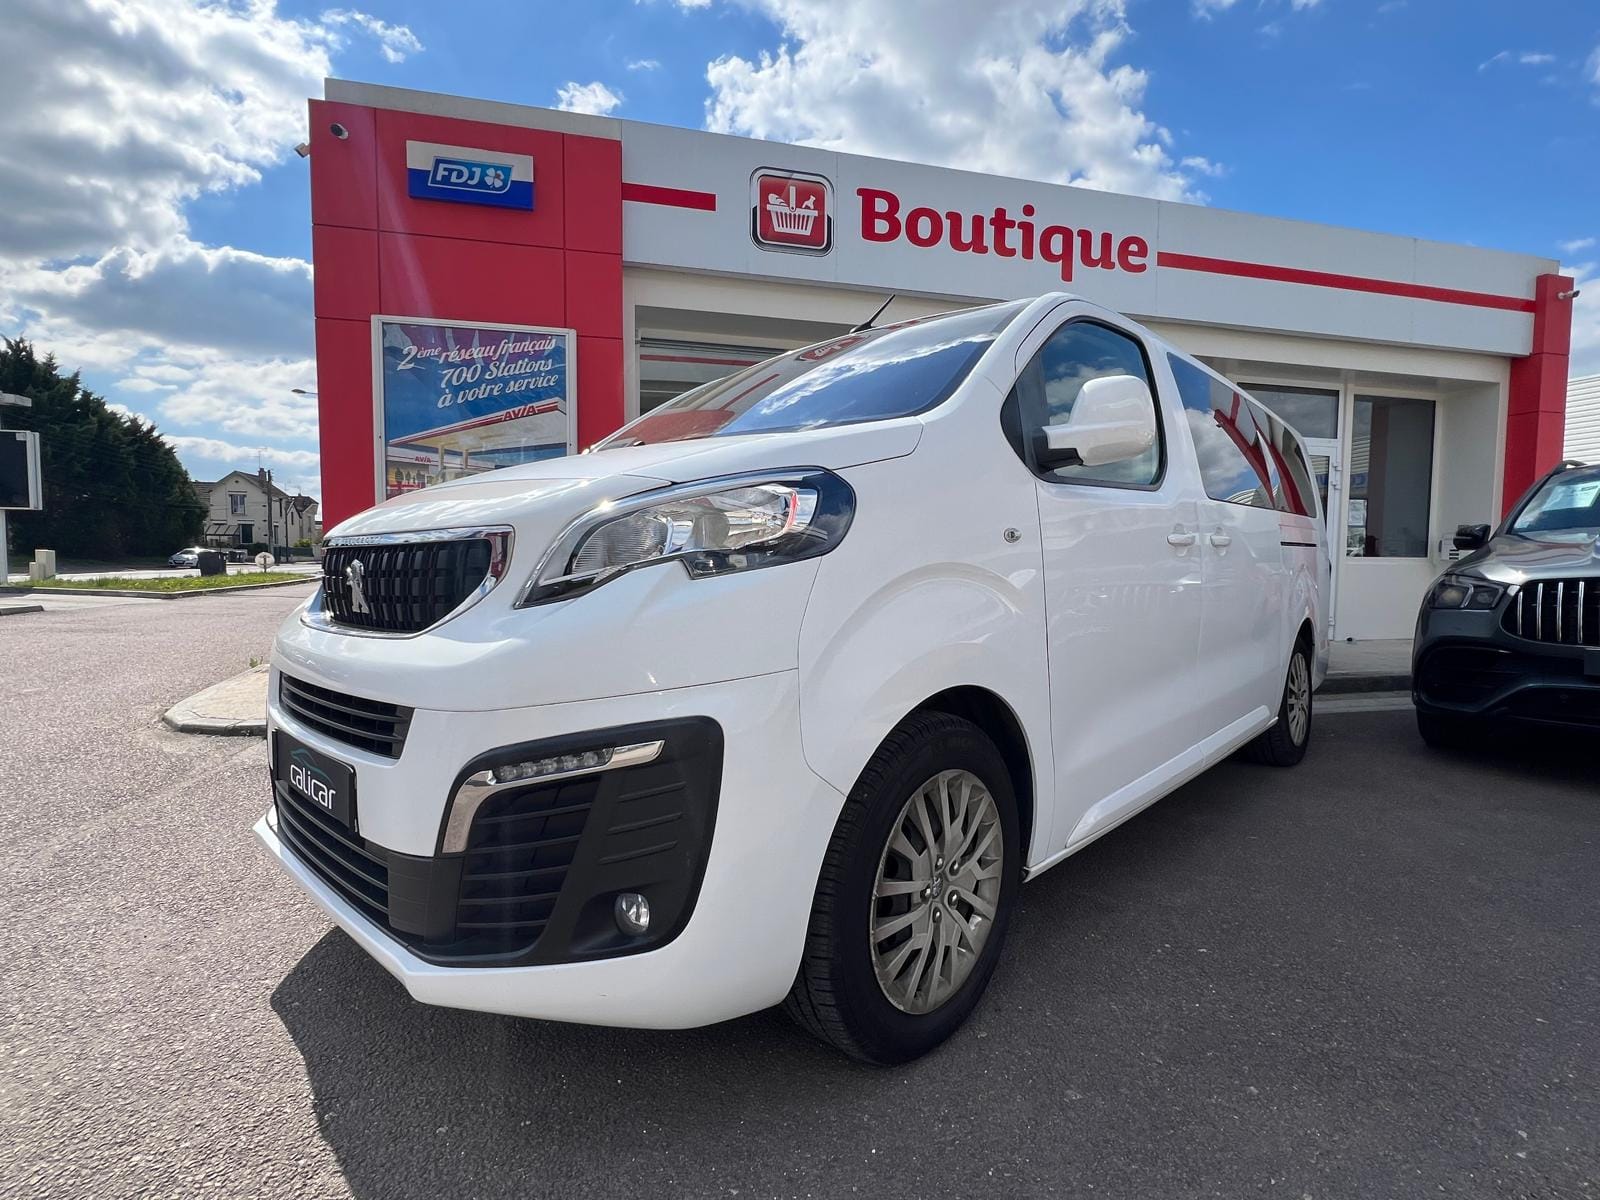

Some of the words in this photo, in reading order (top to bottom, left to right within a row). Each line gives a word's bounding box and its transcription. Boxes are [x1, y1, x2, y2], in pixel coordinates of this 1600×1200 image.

[436, 163, 482, 185] FDJ
[856, 187, 1149, 283] Boutique
[397, 345, 442, 371] 2ème
[438, 344, 495, 364] réseau
[492, 336, 557, 360] français
[437, 388, 453, 409] à
[457, 382, 504, 404] votre
[505, 372, 559, 393] service
[440, 363, 482, 389] 700
[484, 358, 553, 380] Stations
[503, 404, 538, 421] AVIA
[290, 764, 336, 810] calicar
